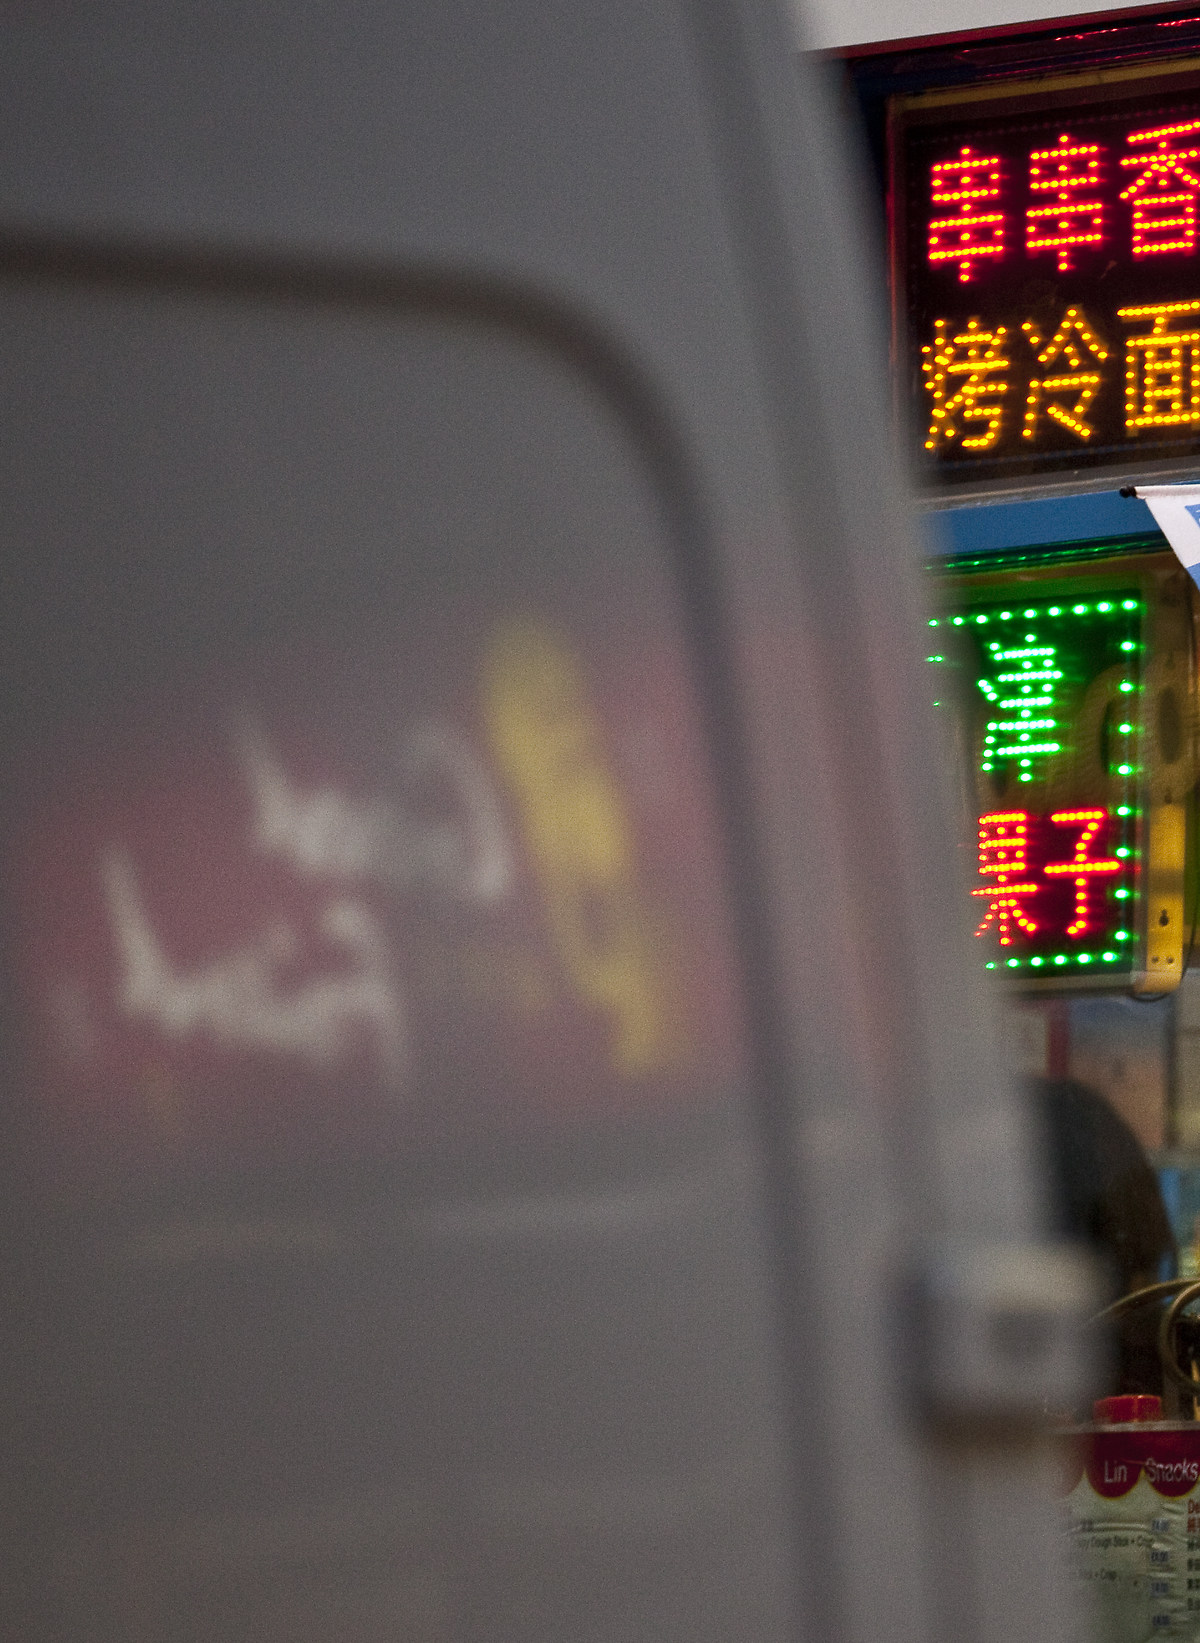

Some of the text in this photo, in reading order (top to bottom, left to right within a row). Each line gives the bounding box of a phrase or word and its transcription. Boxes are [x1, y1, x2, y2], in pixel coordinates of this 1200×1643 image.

[926, 633, 1064, 783] 津
[971, 809, 1122, 947] 果子
[1104, 1457, 1199, 1483] Lin Snacks
